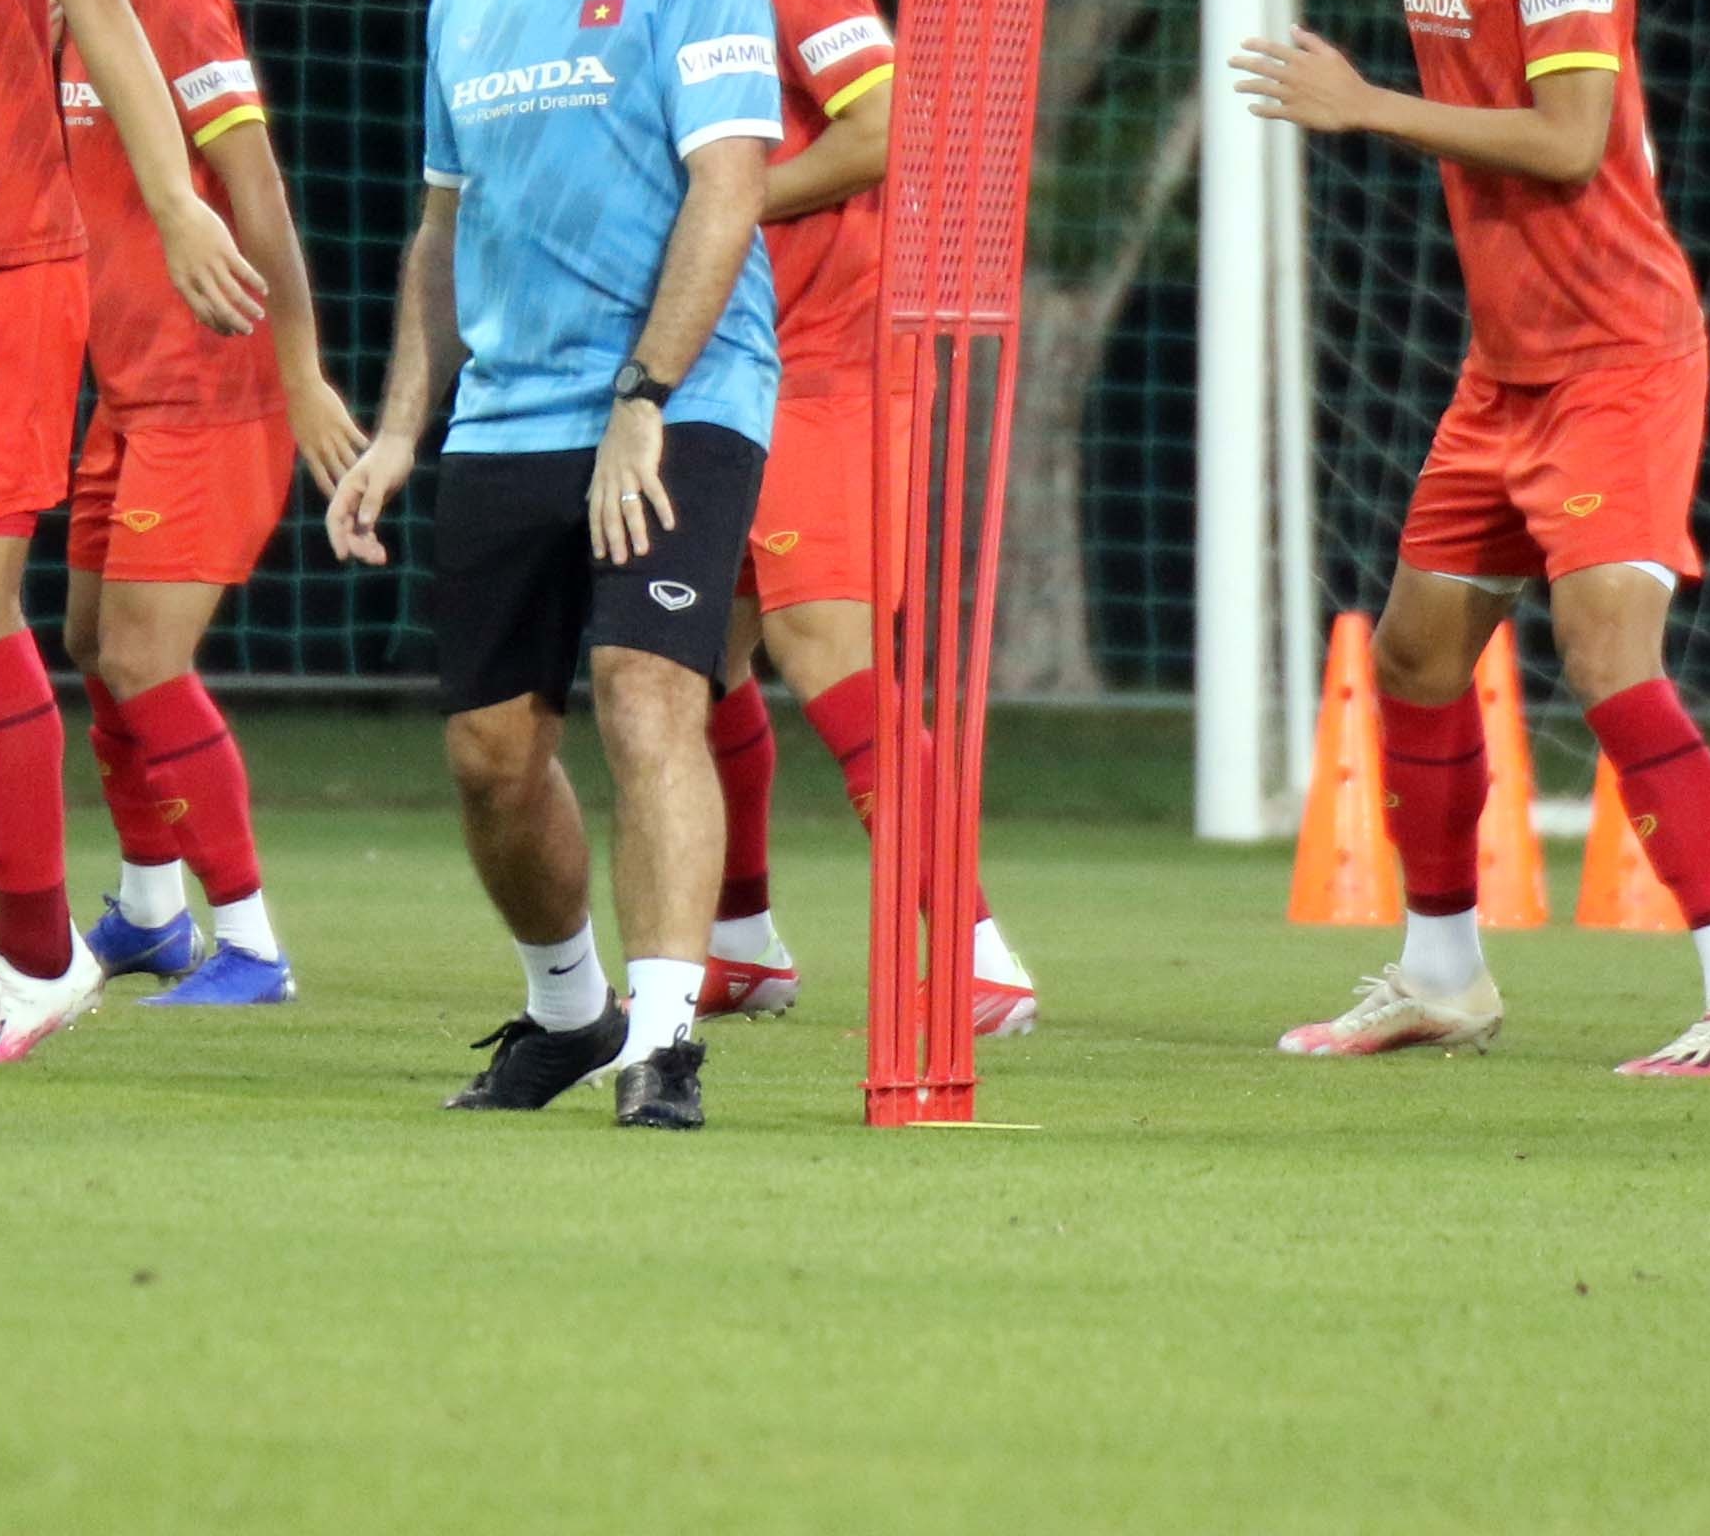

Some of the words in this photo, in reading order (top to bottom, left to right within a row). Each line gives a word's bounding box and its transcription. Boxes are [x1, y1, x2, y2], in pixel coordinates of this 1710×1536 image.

[450, 55, 615, 110] HONDA
[519, 97, 535, 113] of
[540, 92, 608, 110] Dreams
